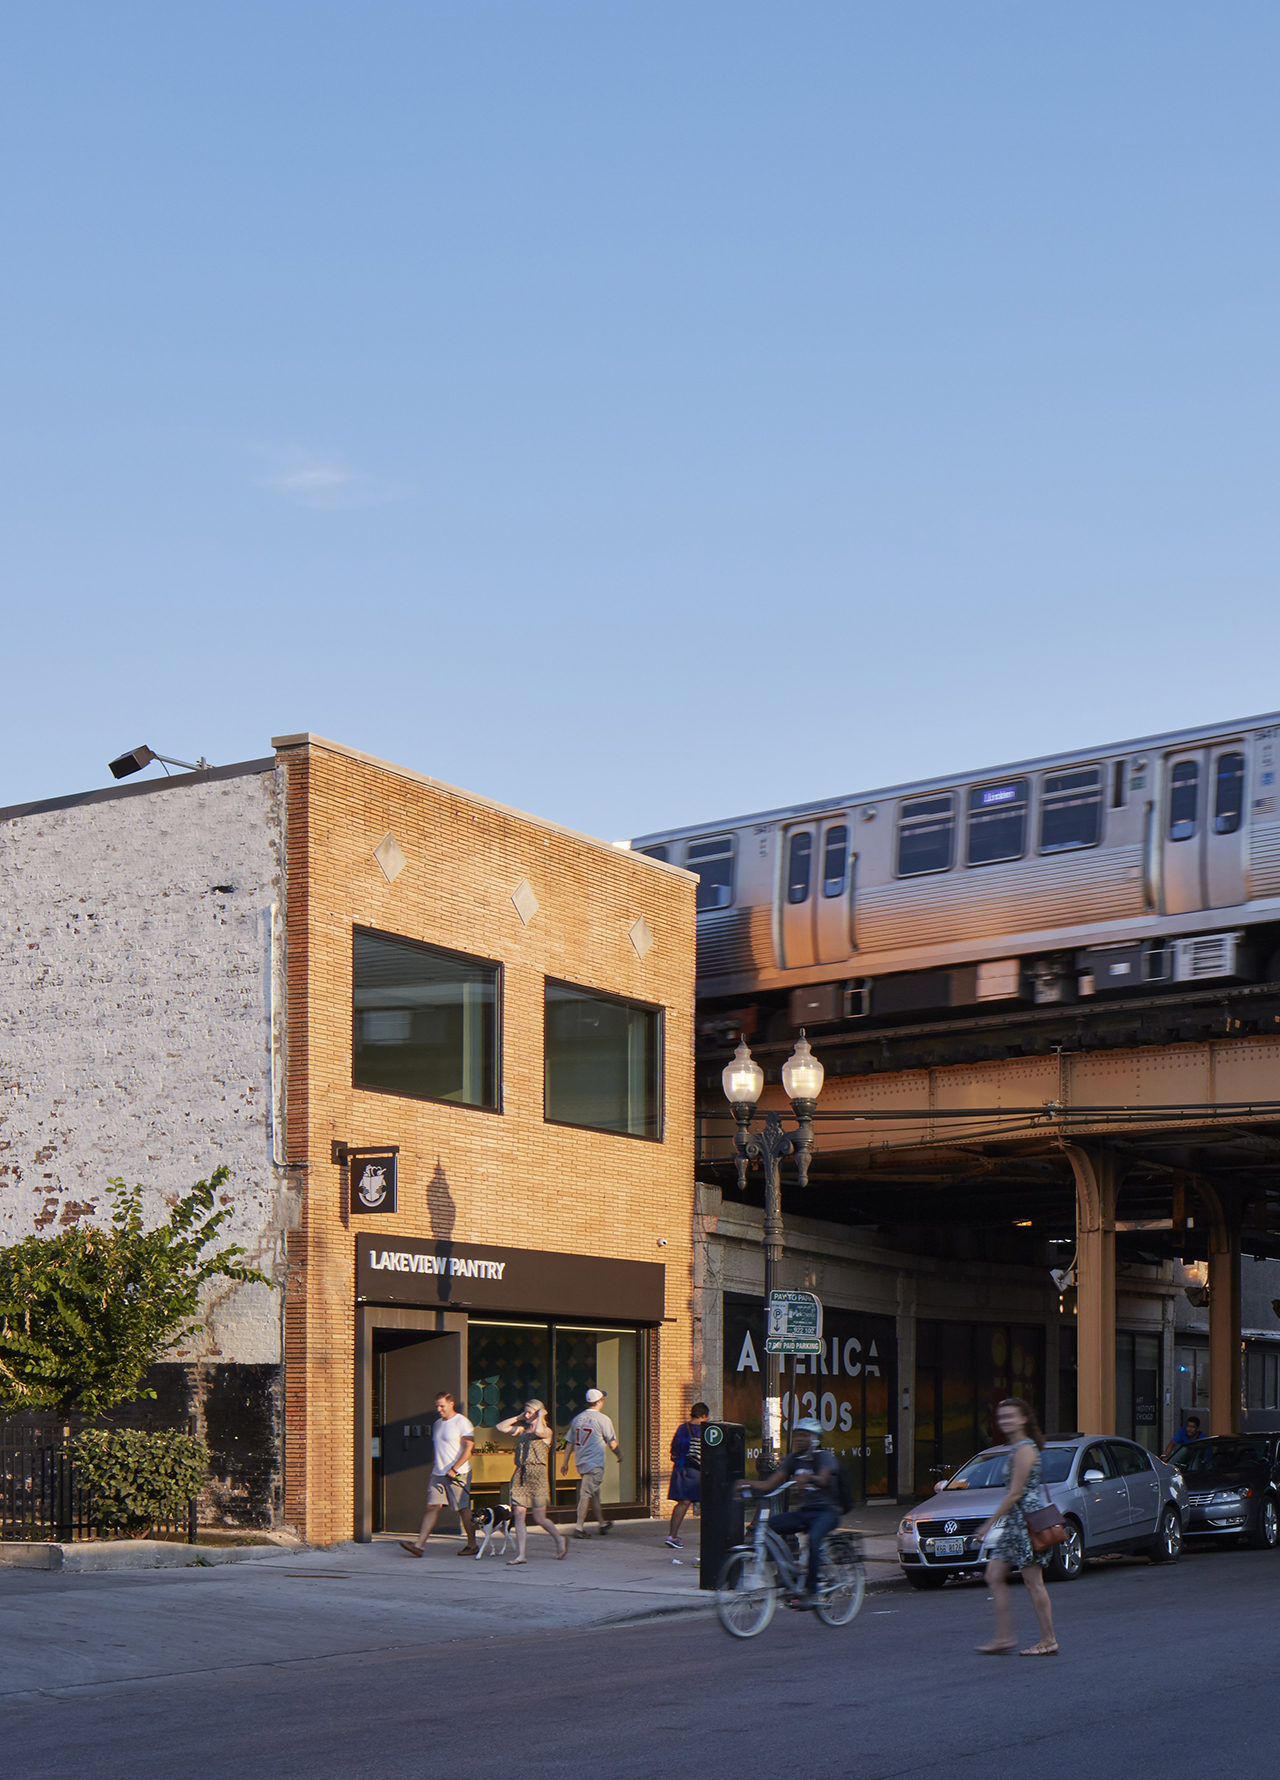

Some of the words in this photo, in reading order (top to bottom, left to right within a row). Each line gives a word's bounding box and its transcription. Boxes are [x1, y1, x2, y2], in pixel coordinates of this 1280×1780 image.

[369, 1250, 447, 1275] LAKEVIEW
[449, 1257, 506, 1280] PANTRY
[787, 1293, 797, 1301] TO
[736, 1330, 881, 1377] ARICA
[575, 1427, 593, 1447] 17
[709, 1429, 718, 1443] P
